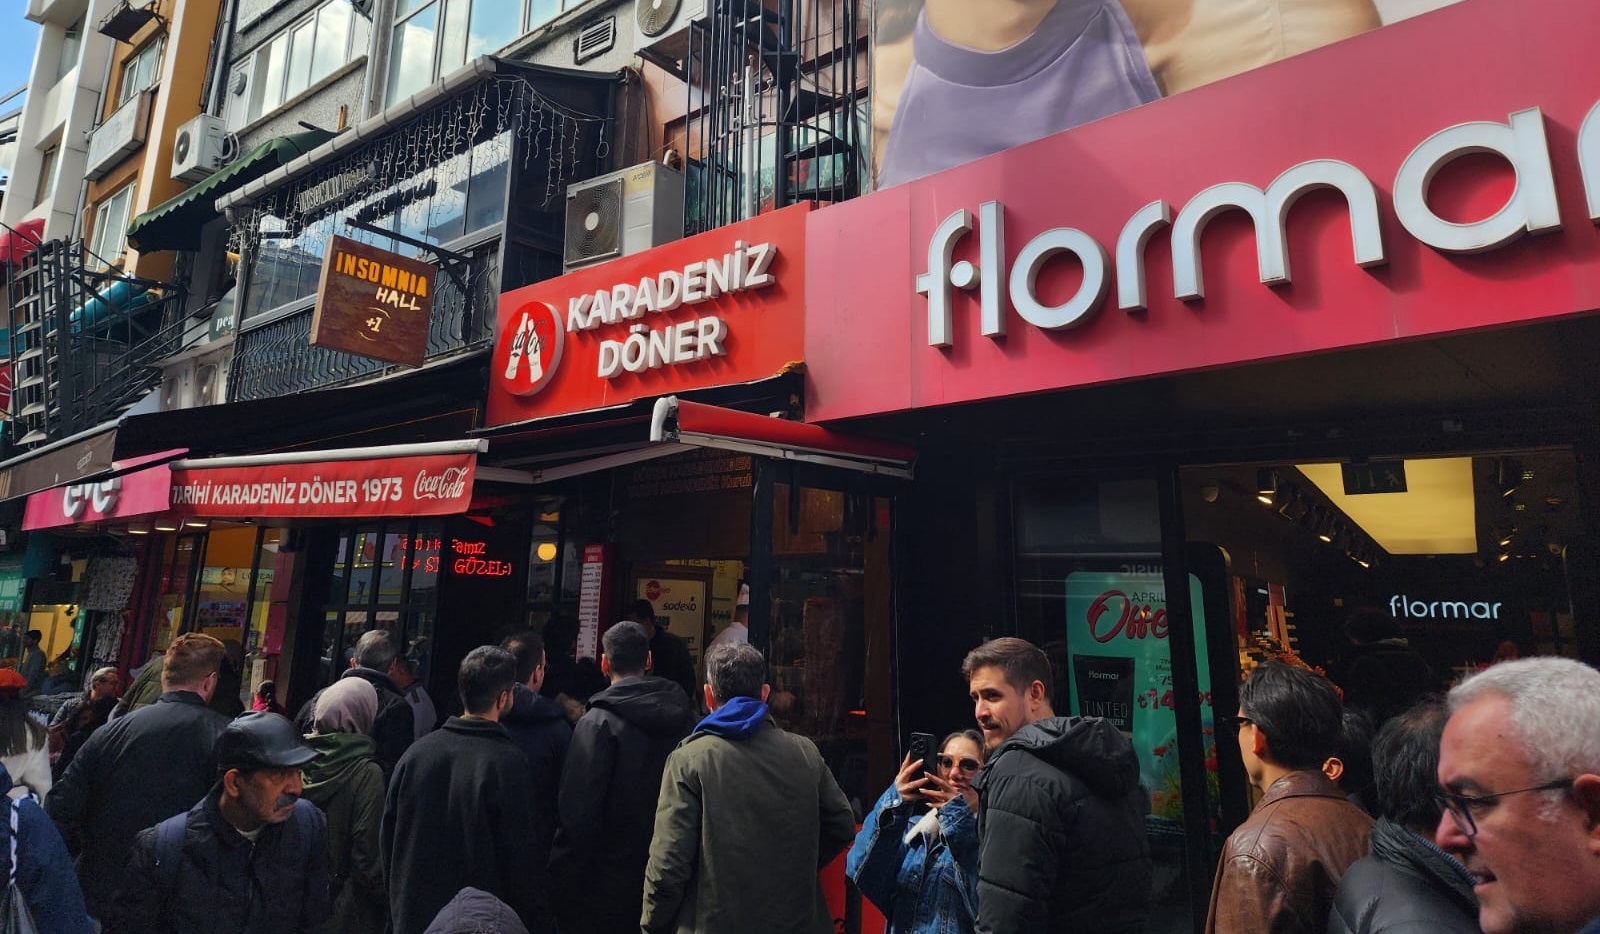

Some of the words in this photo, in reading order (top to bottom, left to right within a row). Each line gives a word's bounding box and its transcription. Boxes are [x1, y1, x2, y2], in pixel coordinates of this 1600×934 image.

[335, 251, 428, 297] INSOMNIA
[567, 240, 776, 332] KARADENİZ
[375, 286, 421, 311] HALL
[366, 316, 382, 332] +1
[598, 316, 728, 379] DÖNER
[172, 480, 211, 505] TARİHİ
[211, 476, 295, 505] KARADENİZ
[298, 476, 357, 504] DÖNER
[362, 476, 402, 502] 1973
[413, 466, 470, 500] Coca-Cola
[1131, 591, 1167, 602] APRIL
[1389, 595, 1502, 619] flormar
[1087, 589, 1169, 643] Offe
